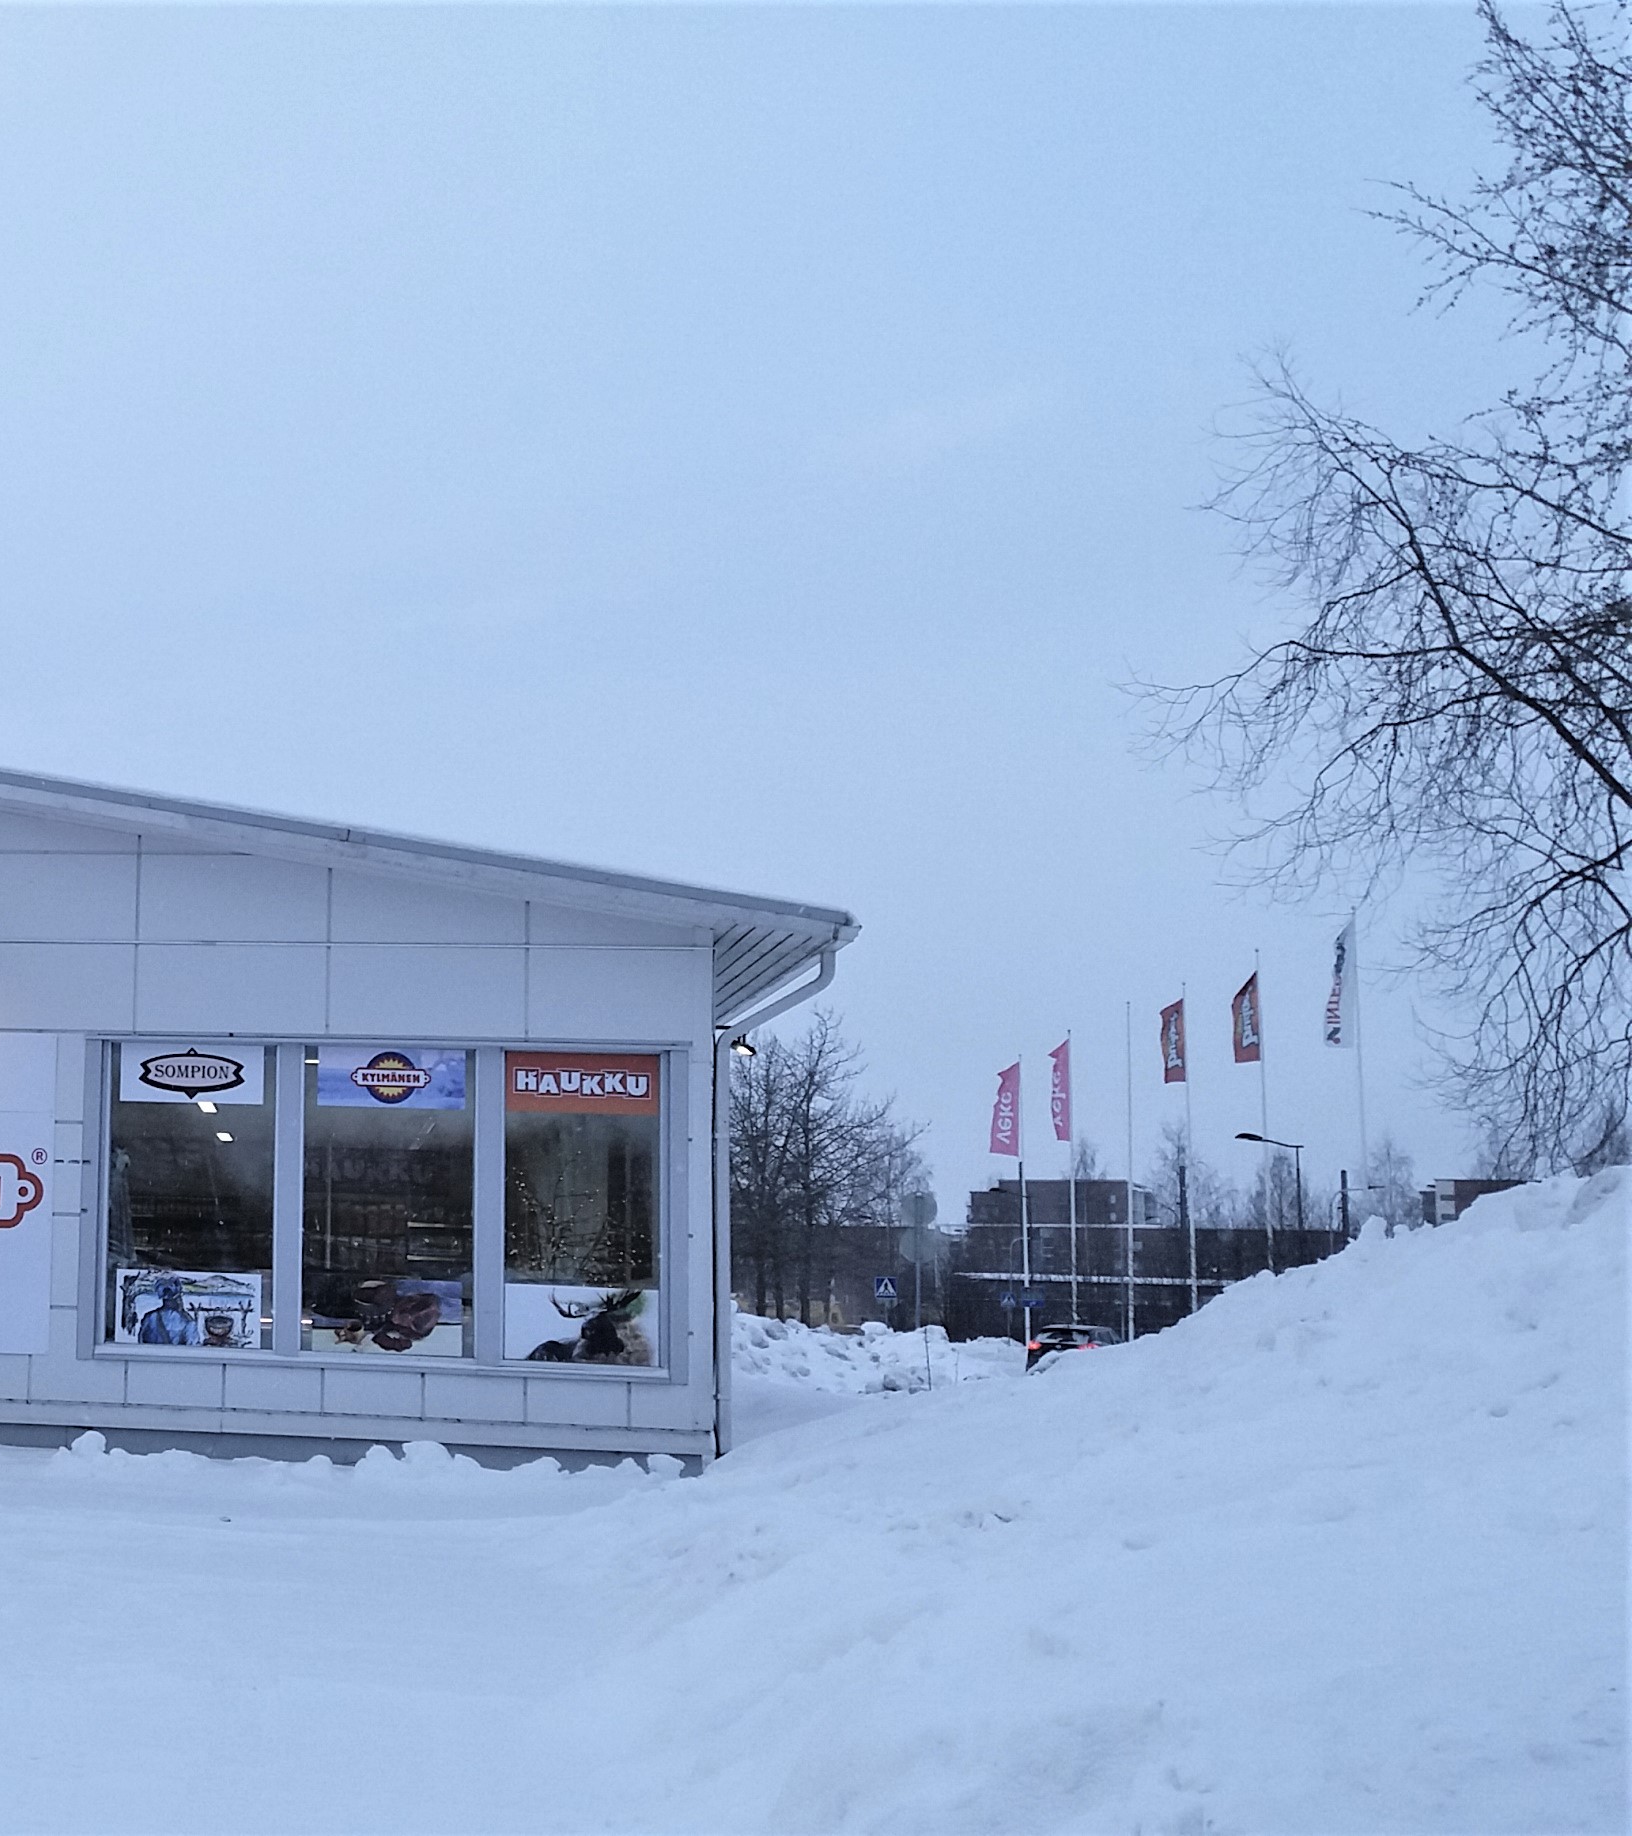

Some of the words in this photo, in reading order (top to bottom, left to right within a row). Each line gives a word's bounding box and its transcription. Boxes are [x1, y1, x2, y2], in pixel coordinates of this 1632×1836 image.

[153, 1063, 230, 1081] SOMPION
[361, 1071, 421, 1085] KYLMÄNEN
[516, 1069, 648, 1097] HAUKKU
